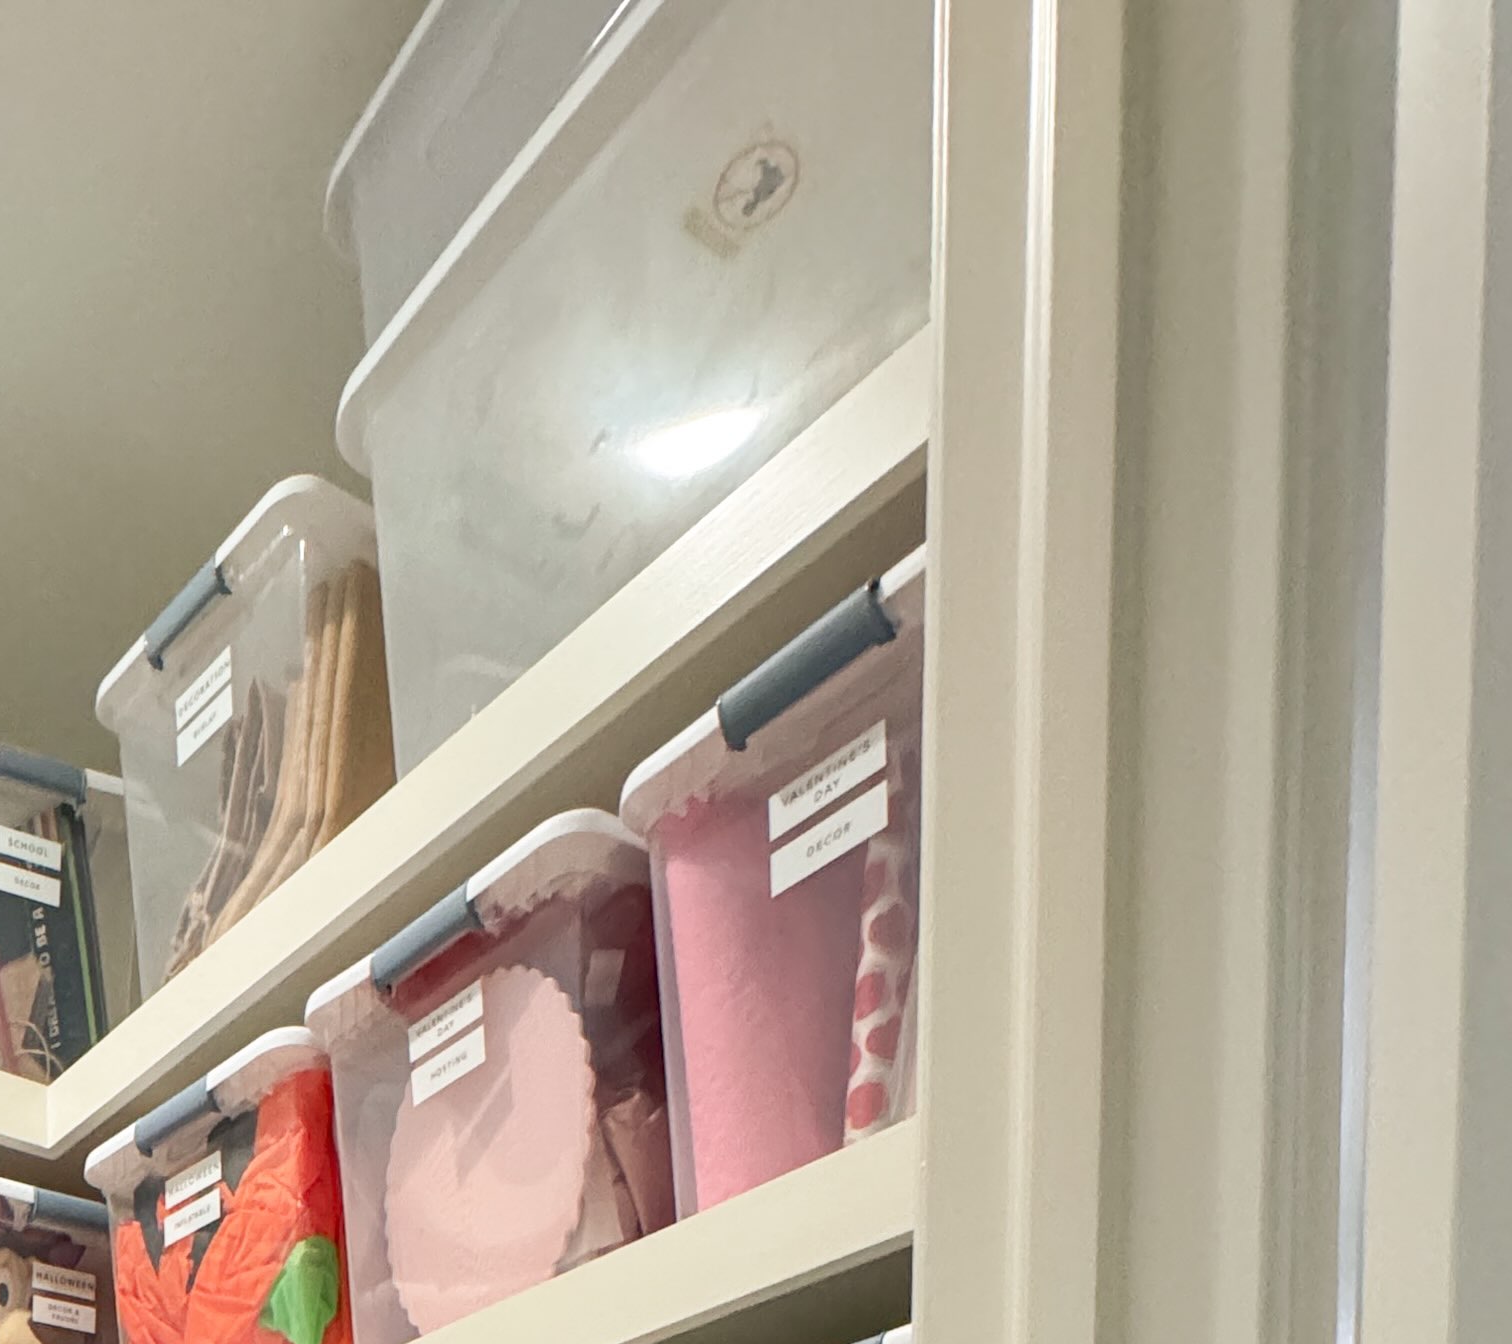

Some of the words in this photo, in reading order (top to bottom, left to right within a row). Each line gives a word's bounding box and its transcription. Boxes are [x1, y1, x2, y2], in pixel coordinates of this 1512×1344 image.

[778, 737, 872, 808] VALENTINE'S
[813, 777, 842, 805] DAY
[7, 836, 48, 859] SCHOOL
[805, 819, 853, 859] DECOR
[14, 875, 41, 892] DECOR
[414, 992, 475, 1038] VALENTINE'S
[436, 1019, 456, 1037] DAY
[429, 1049, 468, 1081] HOSTING
[35, 1270, 95, 1292] HALLOWEEN
